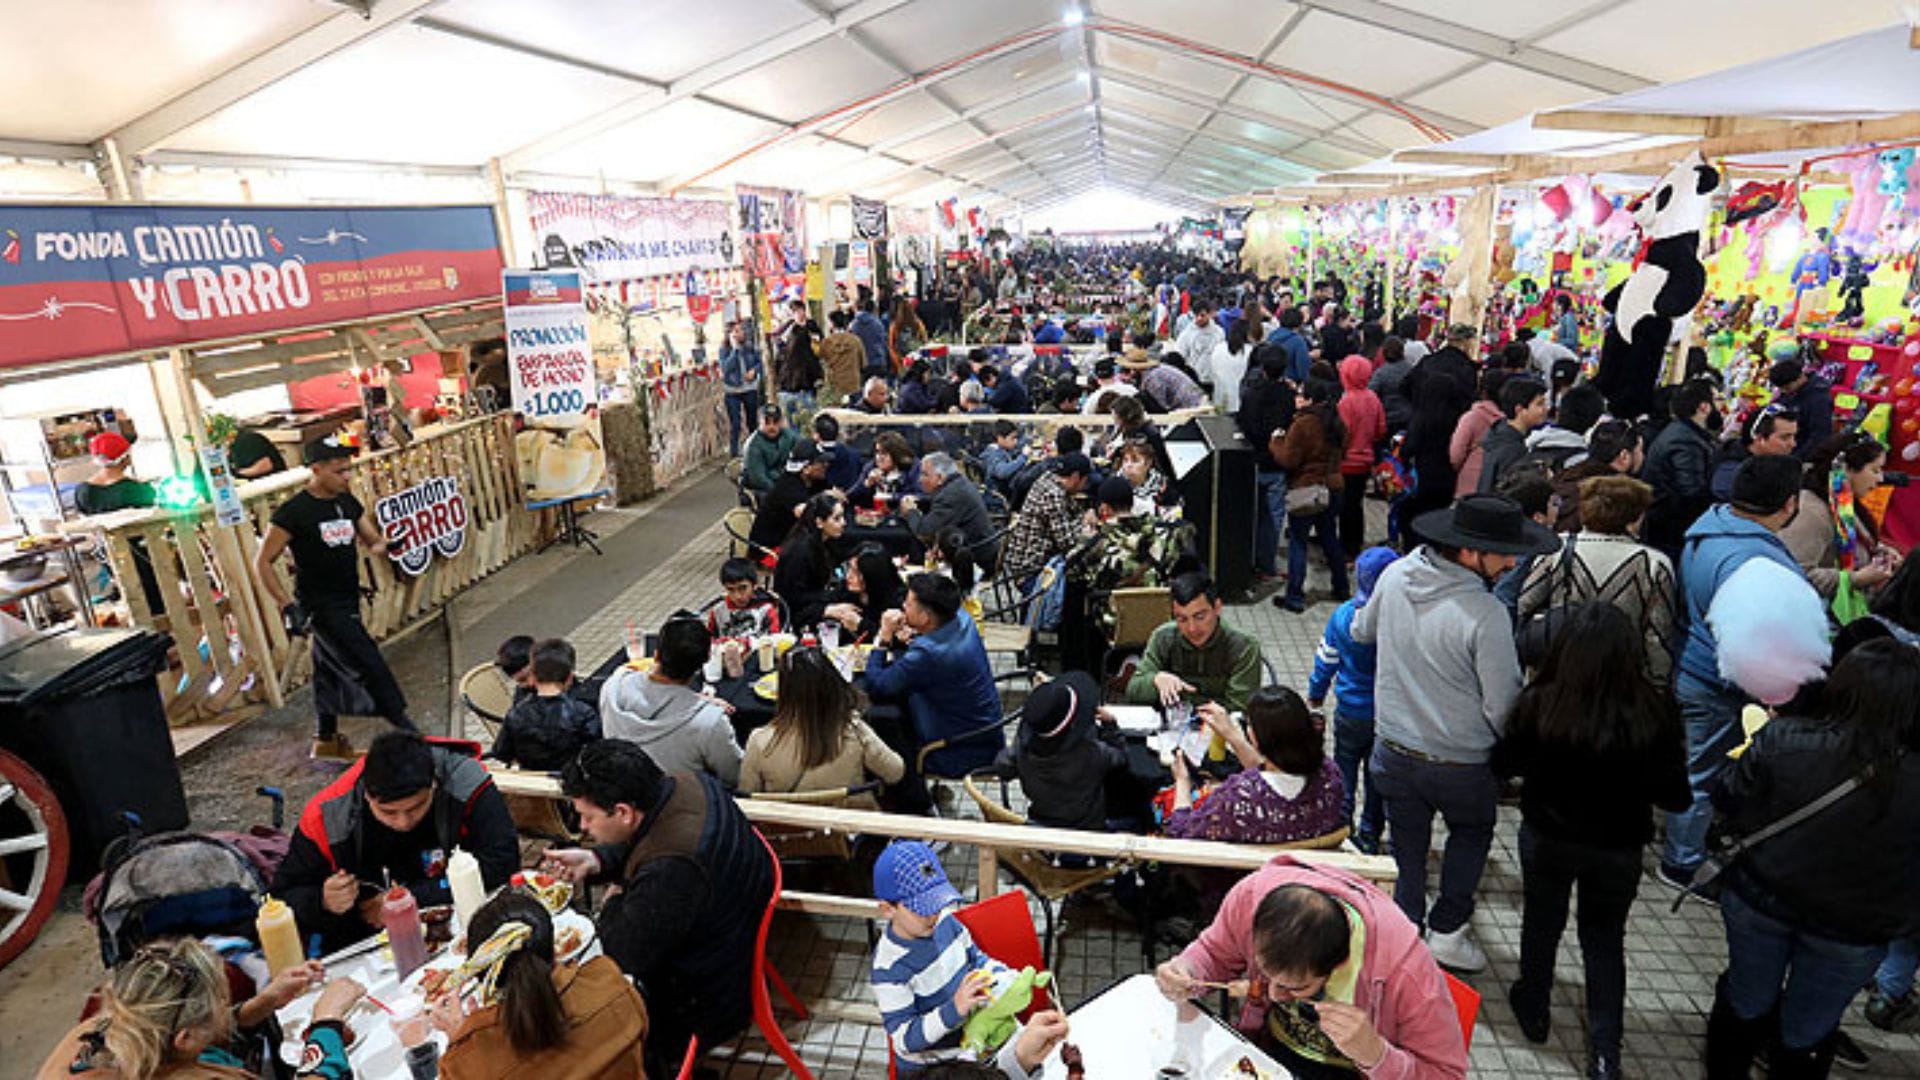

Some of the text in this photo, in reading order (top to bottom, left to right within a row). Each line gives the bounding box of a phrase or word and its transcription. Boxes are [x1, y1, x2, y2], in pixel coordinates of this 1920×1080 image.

[36, 218, 264, 263] FONDA CAMIÓN
[129, 259, 311, 320] Y CARRO
[378, 479, 447, 523] CAMIÓN
[386, 495, 466, 557] CARRO
